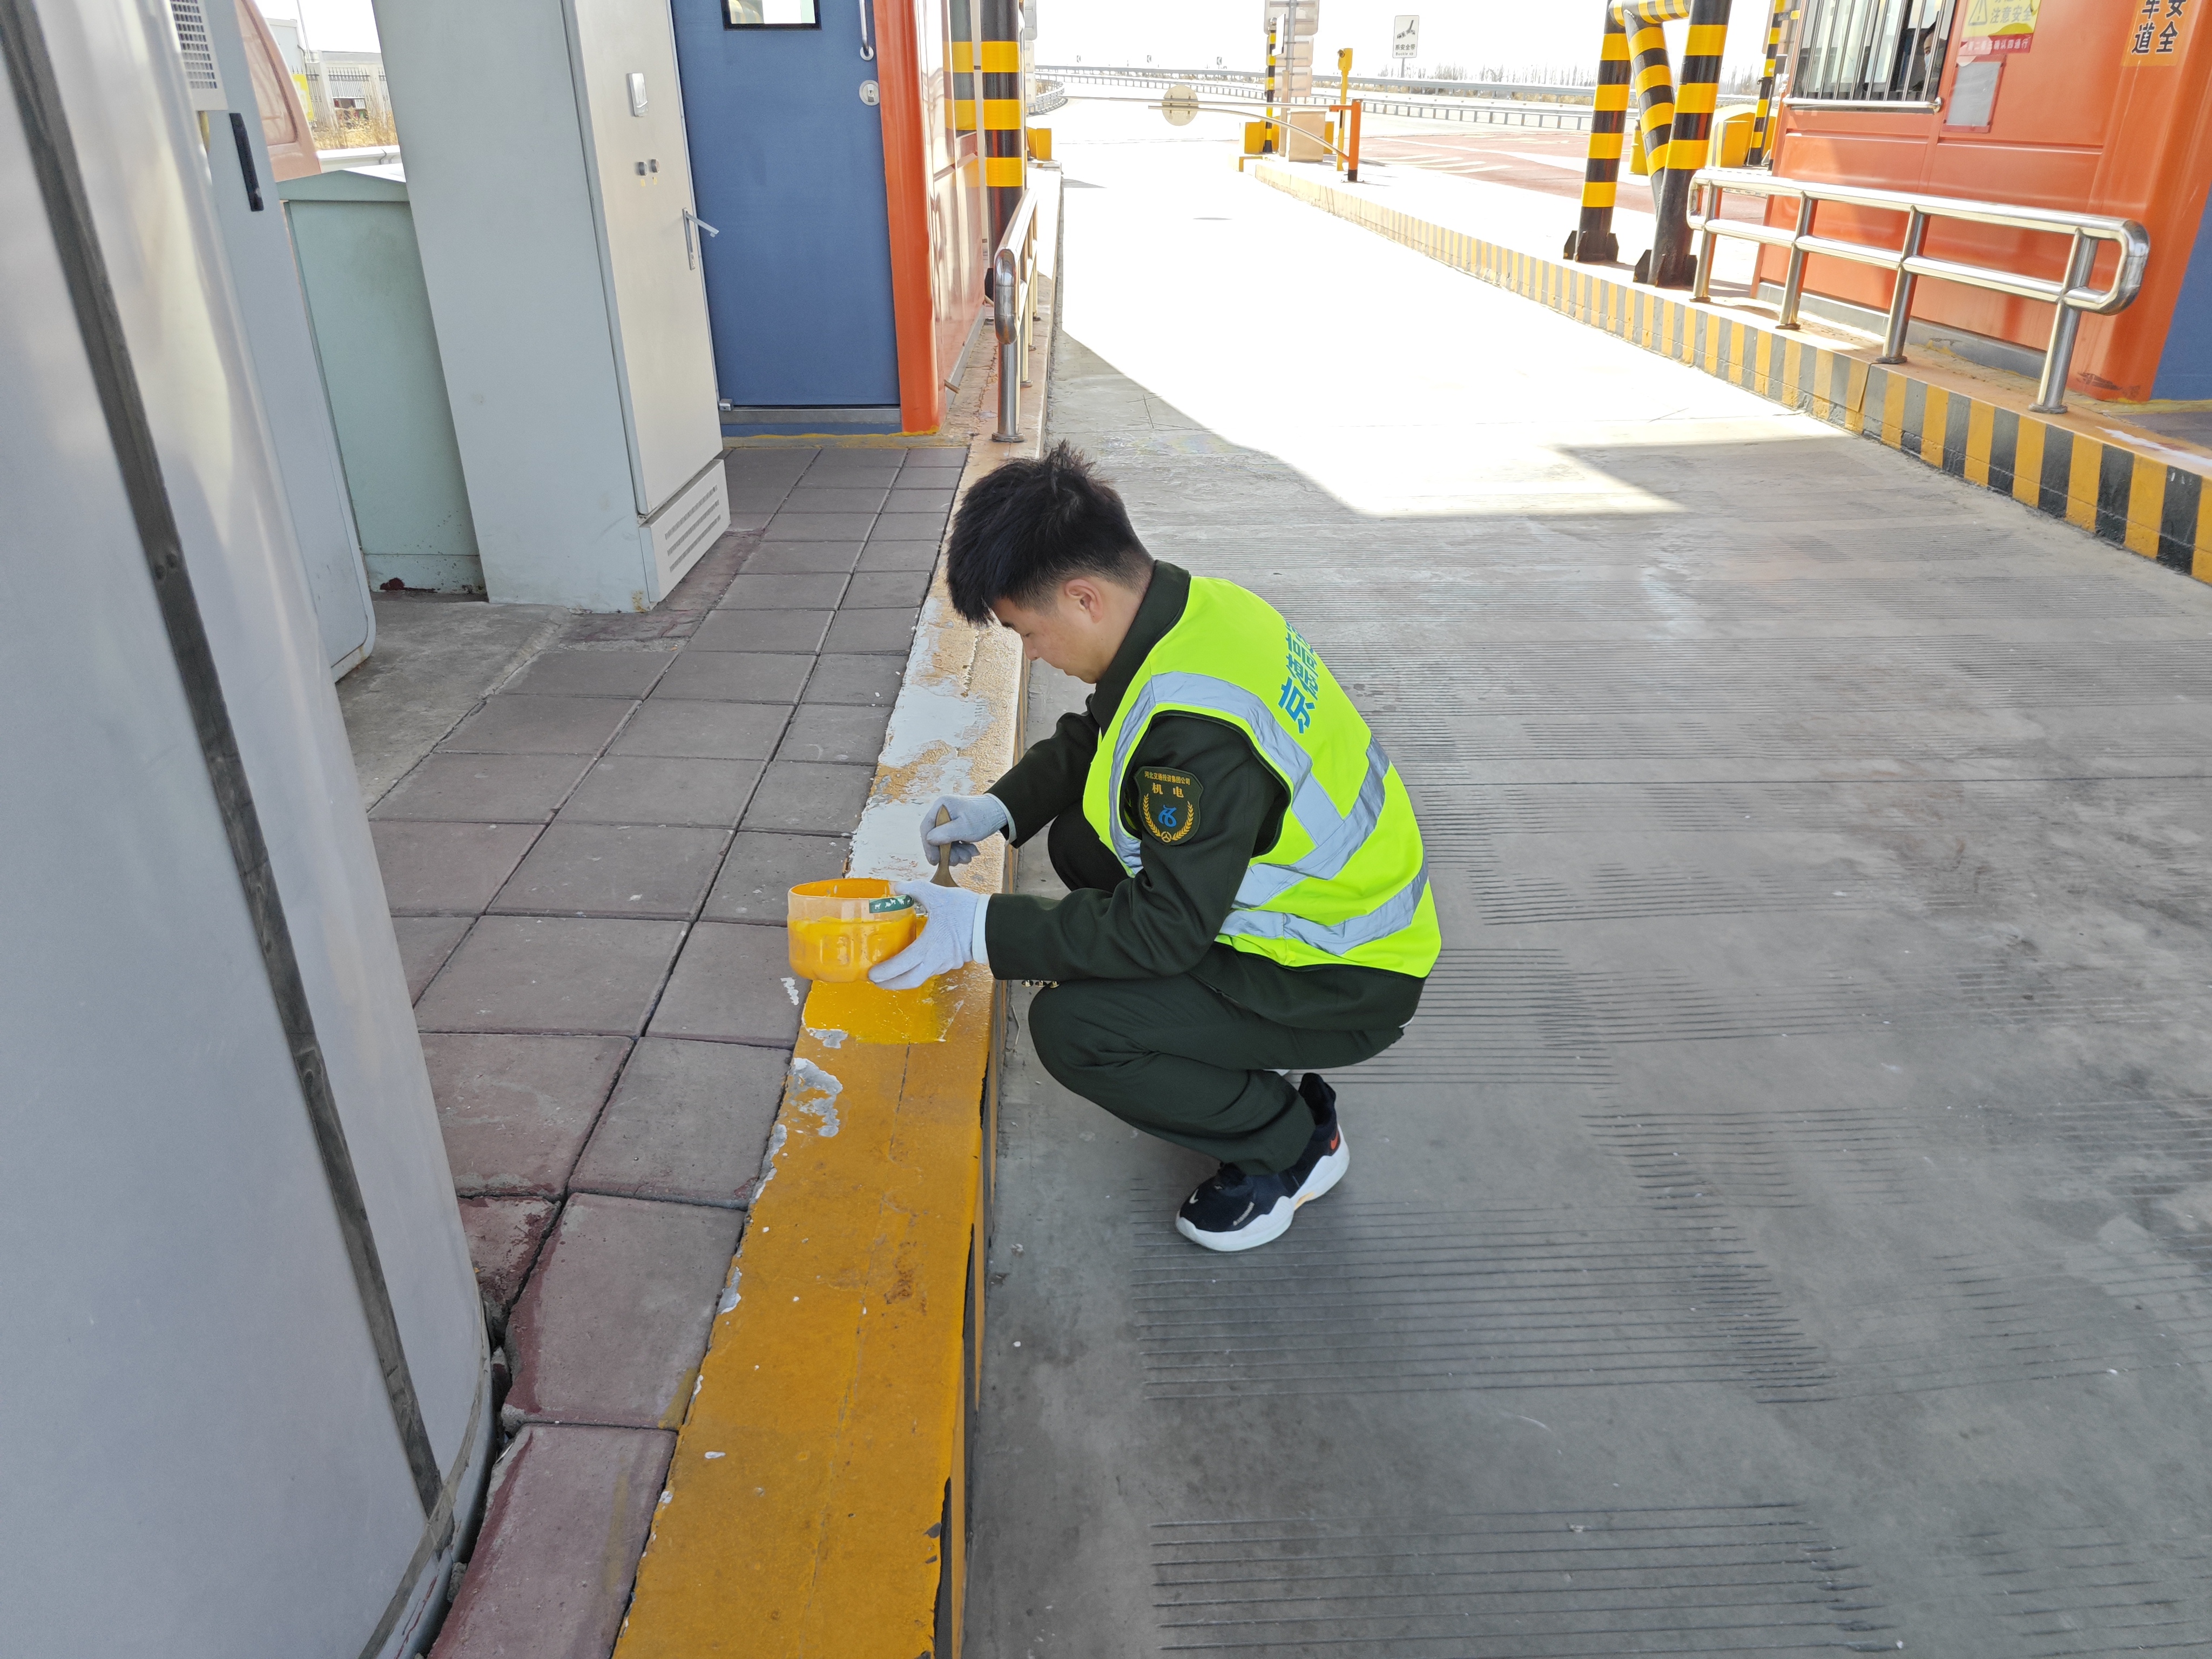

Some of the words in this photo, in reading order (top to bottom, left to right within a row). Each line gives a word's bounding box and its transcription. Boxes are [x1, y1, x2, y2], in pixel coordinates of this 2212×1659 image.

[1990, 5, 2032, 23] 注意安全
[1144, 771, 1190, 786] 河北交通投资集团公司
[1152, 782, 1184, 798] 机电
